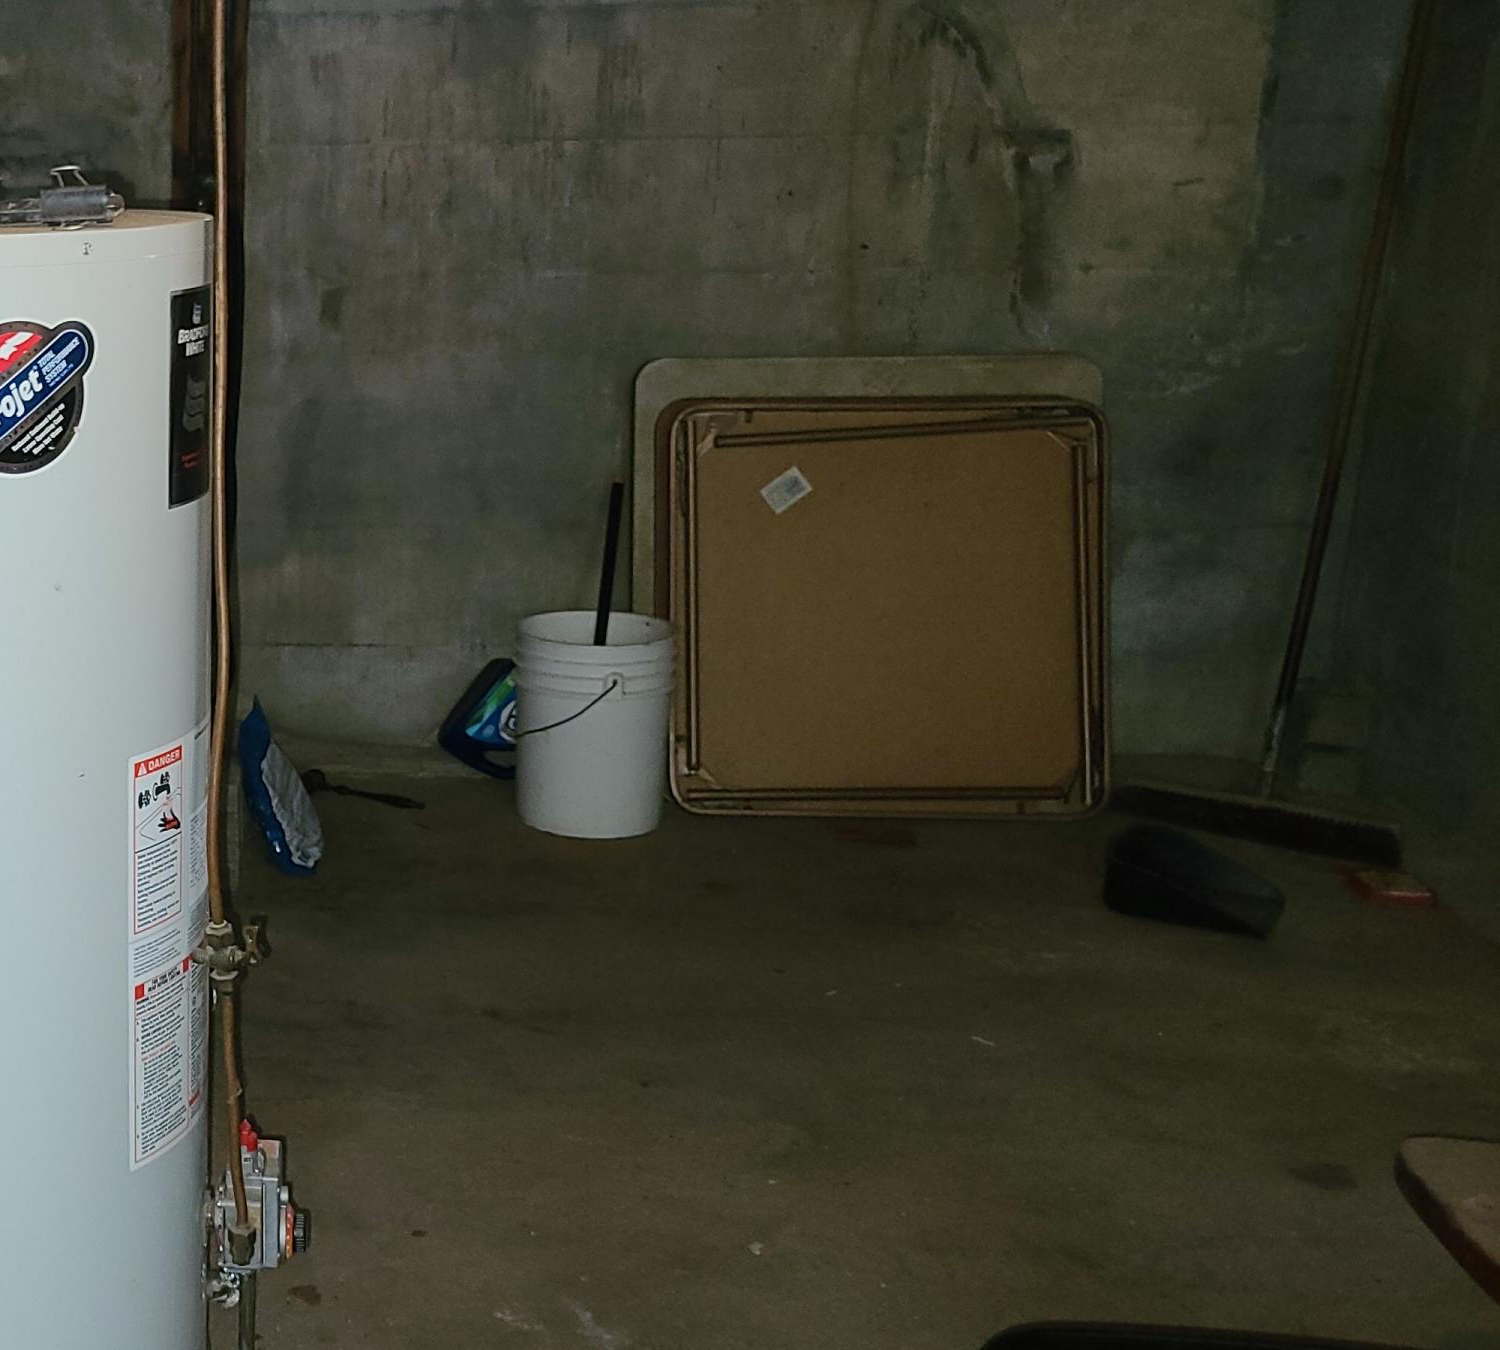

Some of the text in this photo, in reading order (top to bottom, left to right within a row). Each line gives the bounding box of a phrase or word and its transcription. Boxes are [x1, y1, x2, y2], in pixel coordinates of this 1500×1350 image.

[178, 324, 209, 344] BRADFO
[186, 340, 205, 356] WHITE
[45, 359, 67, 383] SYSTEM
[148, 749, 181, 771] DANGER
